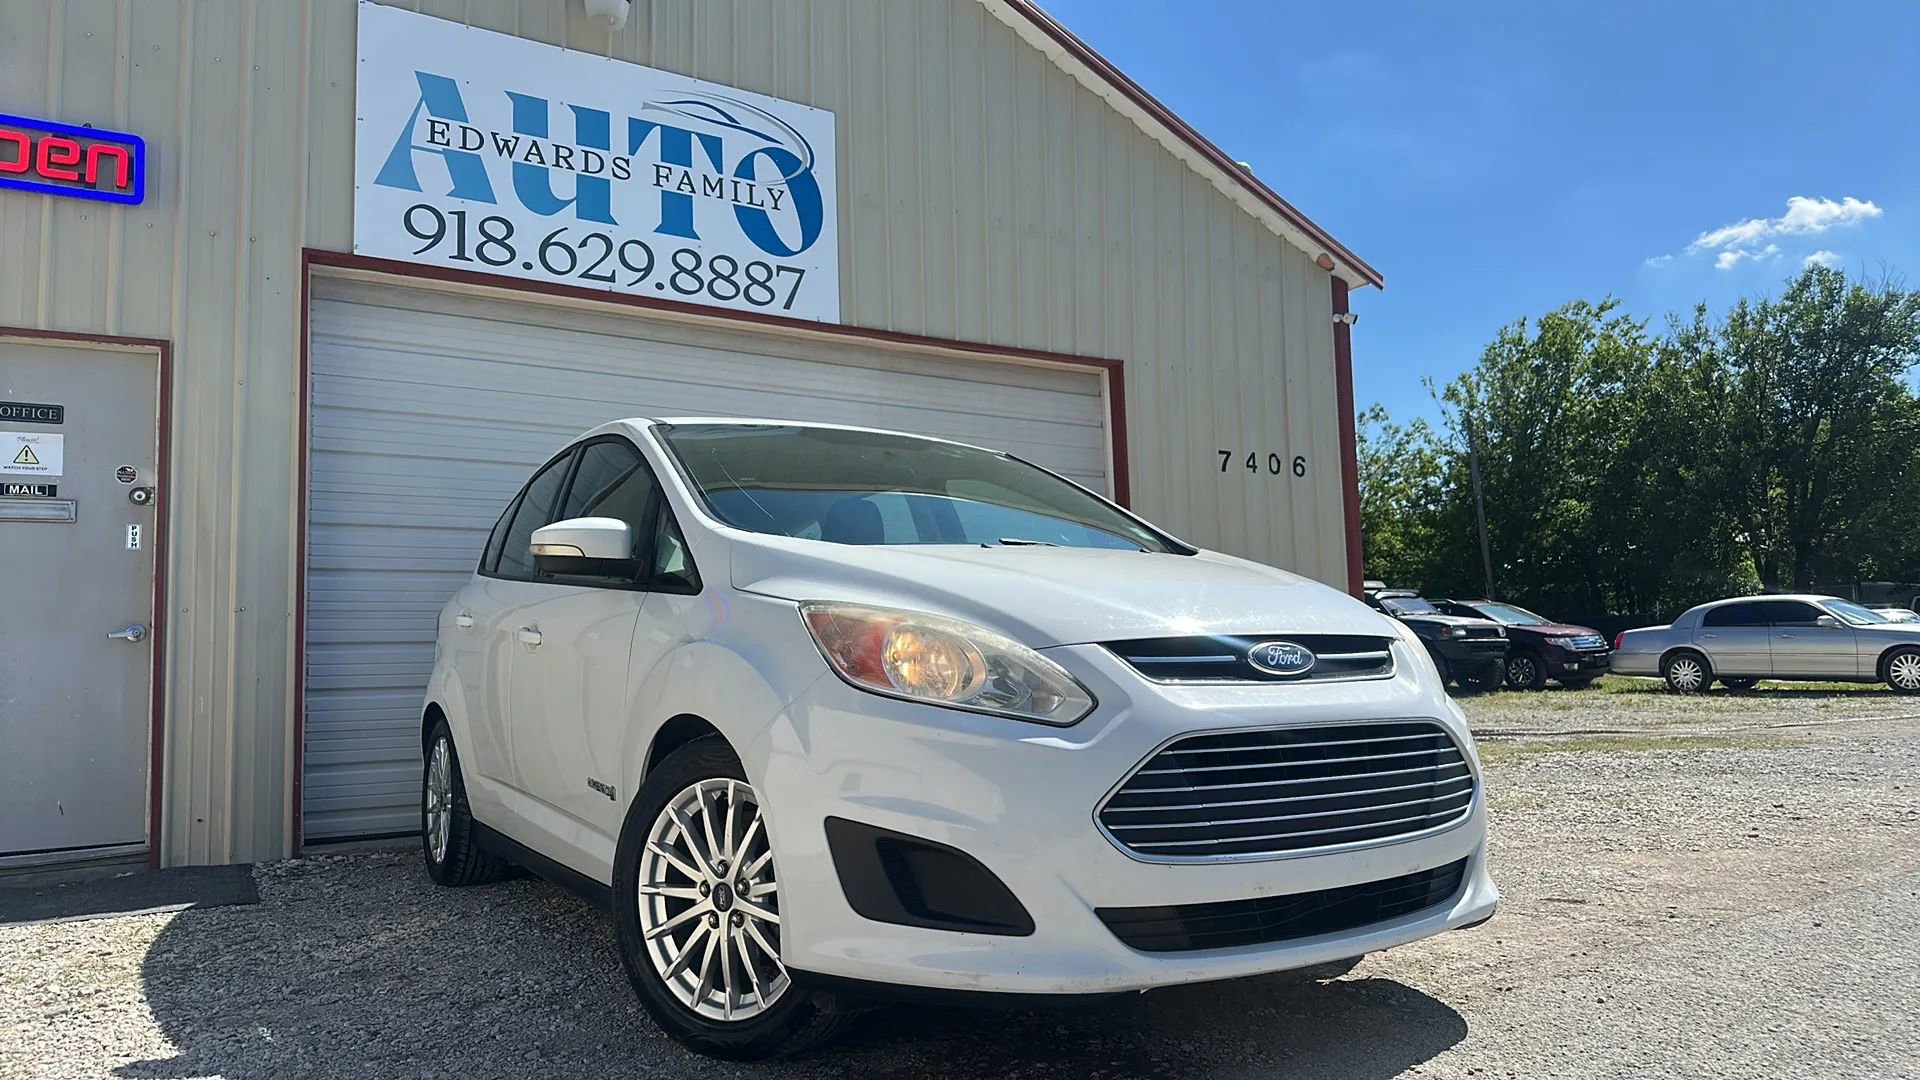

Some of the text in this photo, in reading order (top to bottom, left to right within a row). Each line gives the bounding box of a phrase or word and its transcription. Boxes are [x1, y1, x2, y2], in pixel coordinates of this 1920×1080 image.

[373, 70, 824, 258] AUTO
[426, 118, 785, 211] EDWARDS FAMILY
[403, 203, 806, 310] 918.629.8887
[0, 405, 58, 419] OFFICE
[1218, 450, 1306, 478] 7406
[10, 485, 42, 495] MAIL
[1267, 646, 1303, 666] Ford
